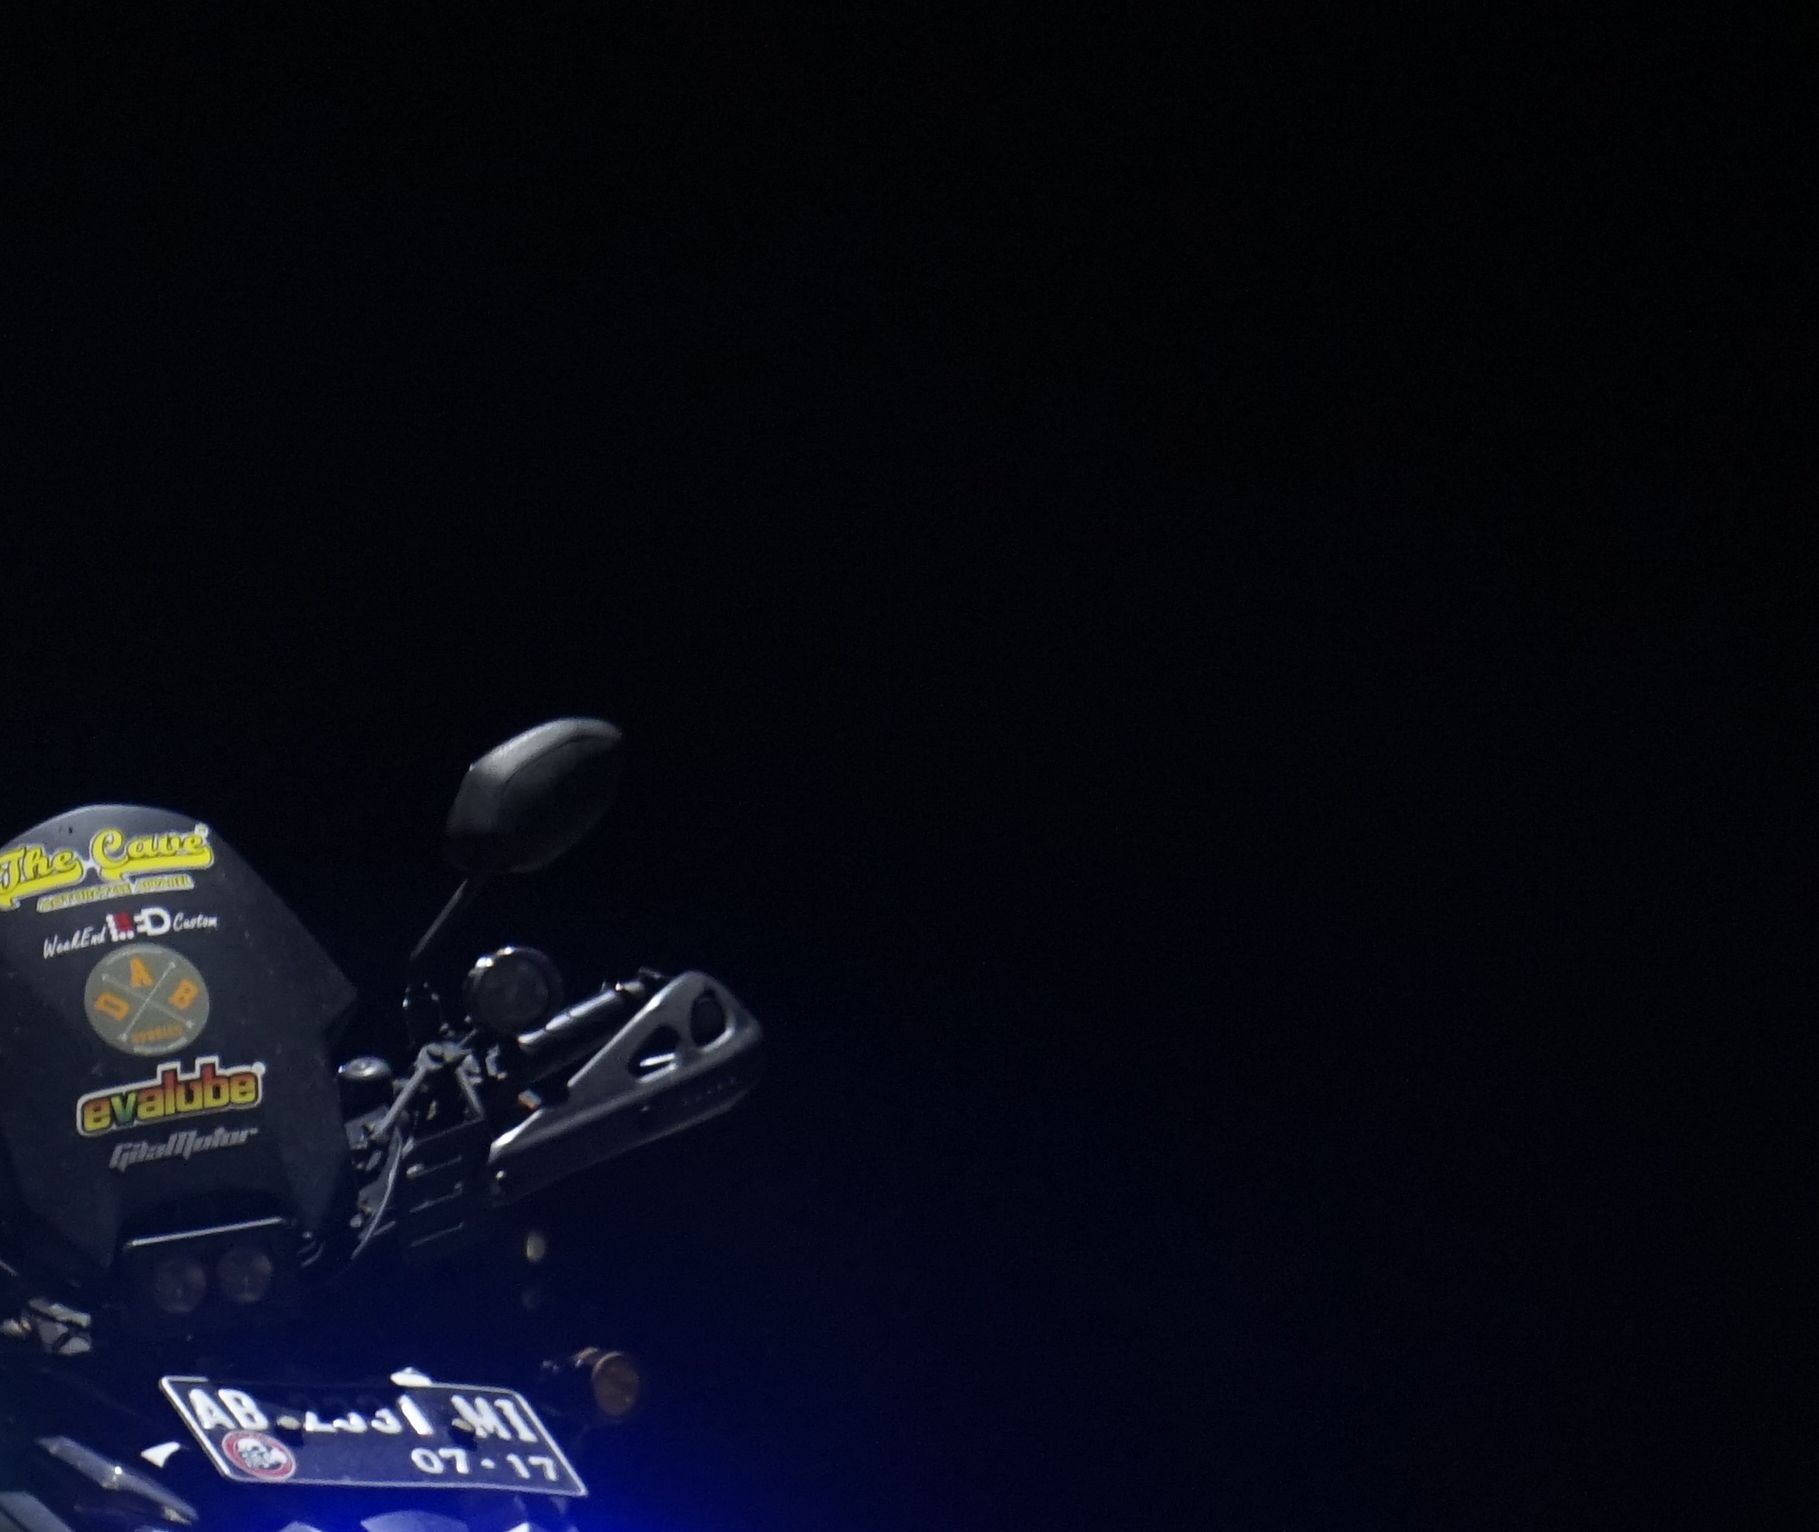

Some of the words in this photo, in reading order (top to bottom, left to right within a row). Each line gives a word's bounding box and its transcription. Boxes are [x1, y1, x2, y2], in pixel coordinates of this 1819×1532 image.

[91, 828, 213, 878] Cave
[172, 912, 218, 932] Custom
[82, 1063, 259, 1134] evalube
[188, 1387, 269, 1431] AB
